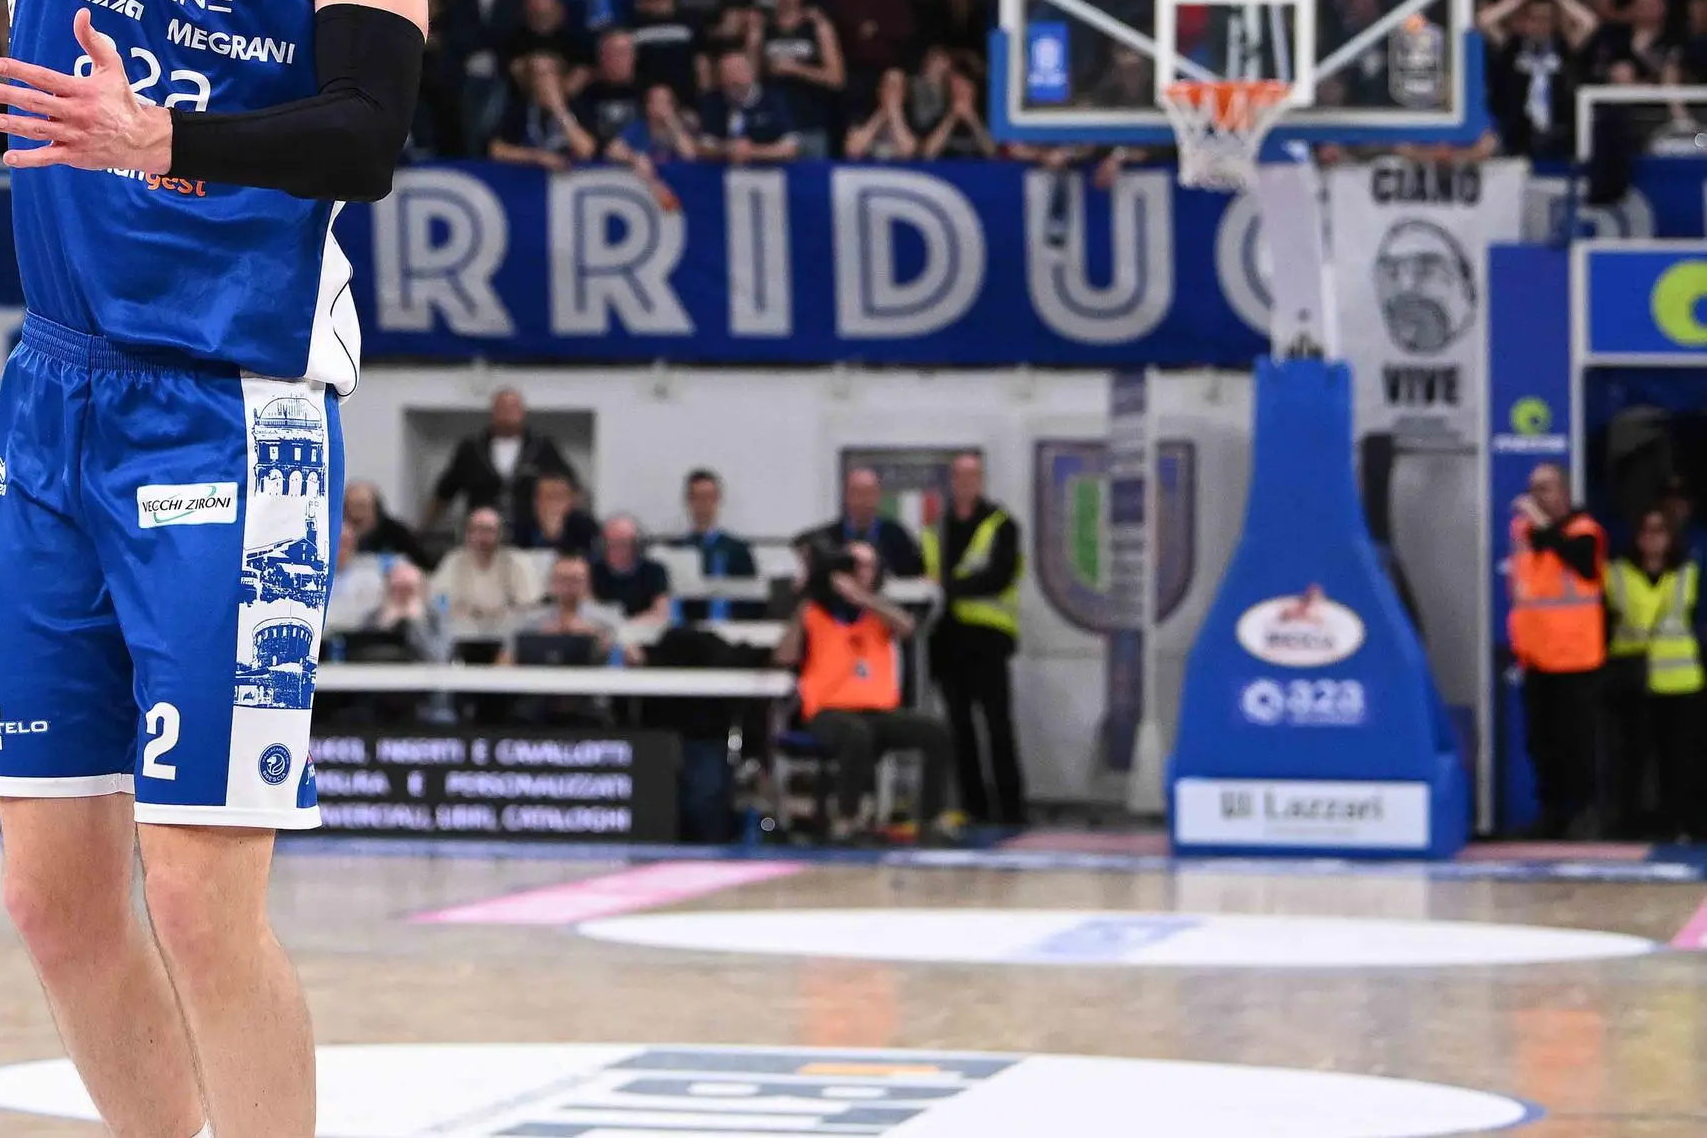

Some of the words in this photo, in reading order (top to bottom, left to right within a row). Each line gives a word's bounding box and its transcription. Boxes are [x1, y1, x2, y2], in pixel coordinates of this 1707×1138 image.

[166, 18, 296, 65] MEGRANI
[1382, 364, 1460, 405] VIVE
[142, 498, 183, 513] VECCHI
[185, 496, 231, 511] ZIRONI
[141, 700, 181, 781] 2
[262, 769, 287, 782] BRESCIA
[1263, 786, 1383, 820] Lazzari
